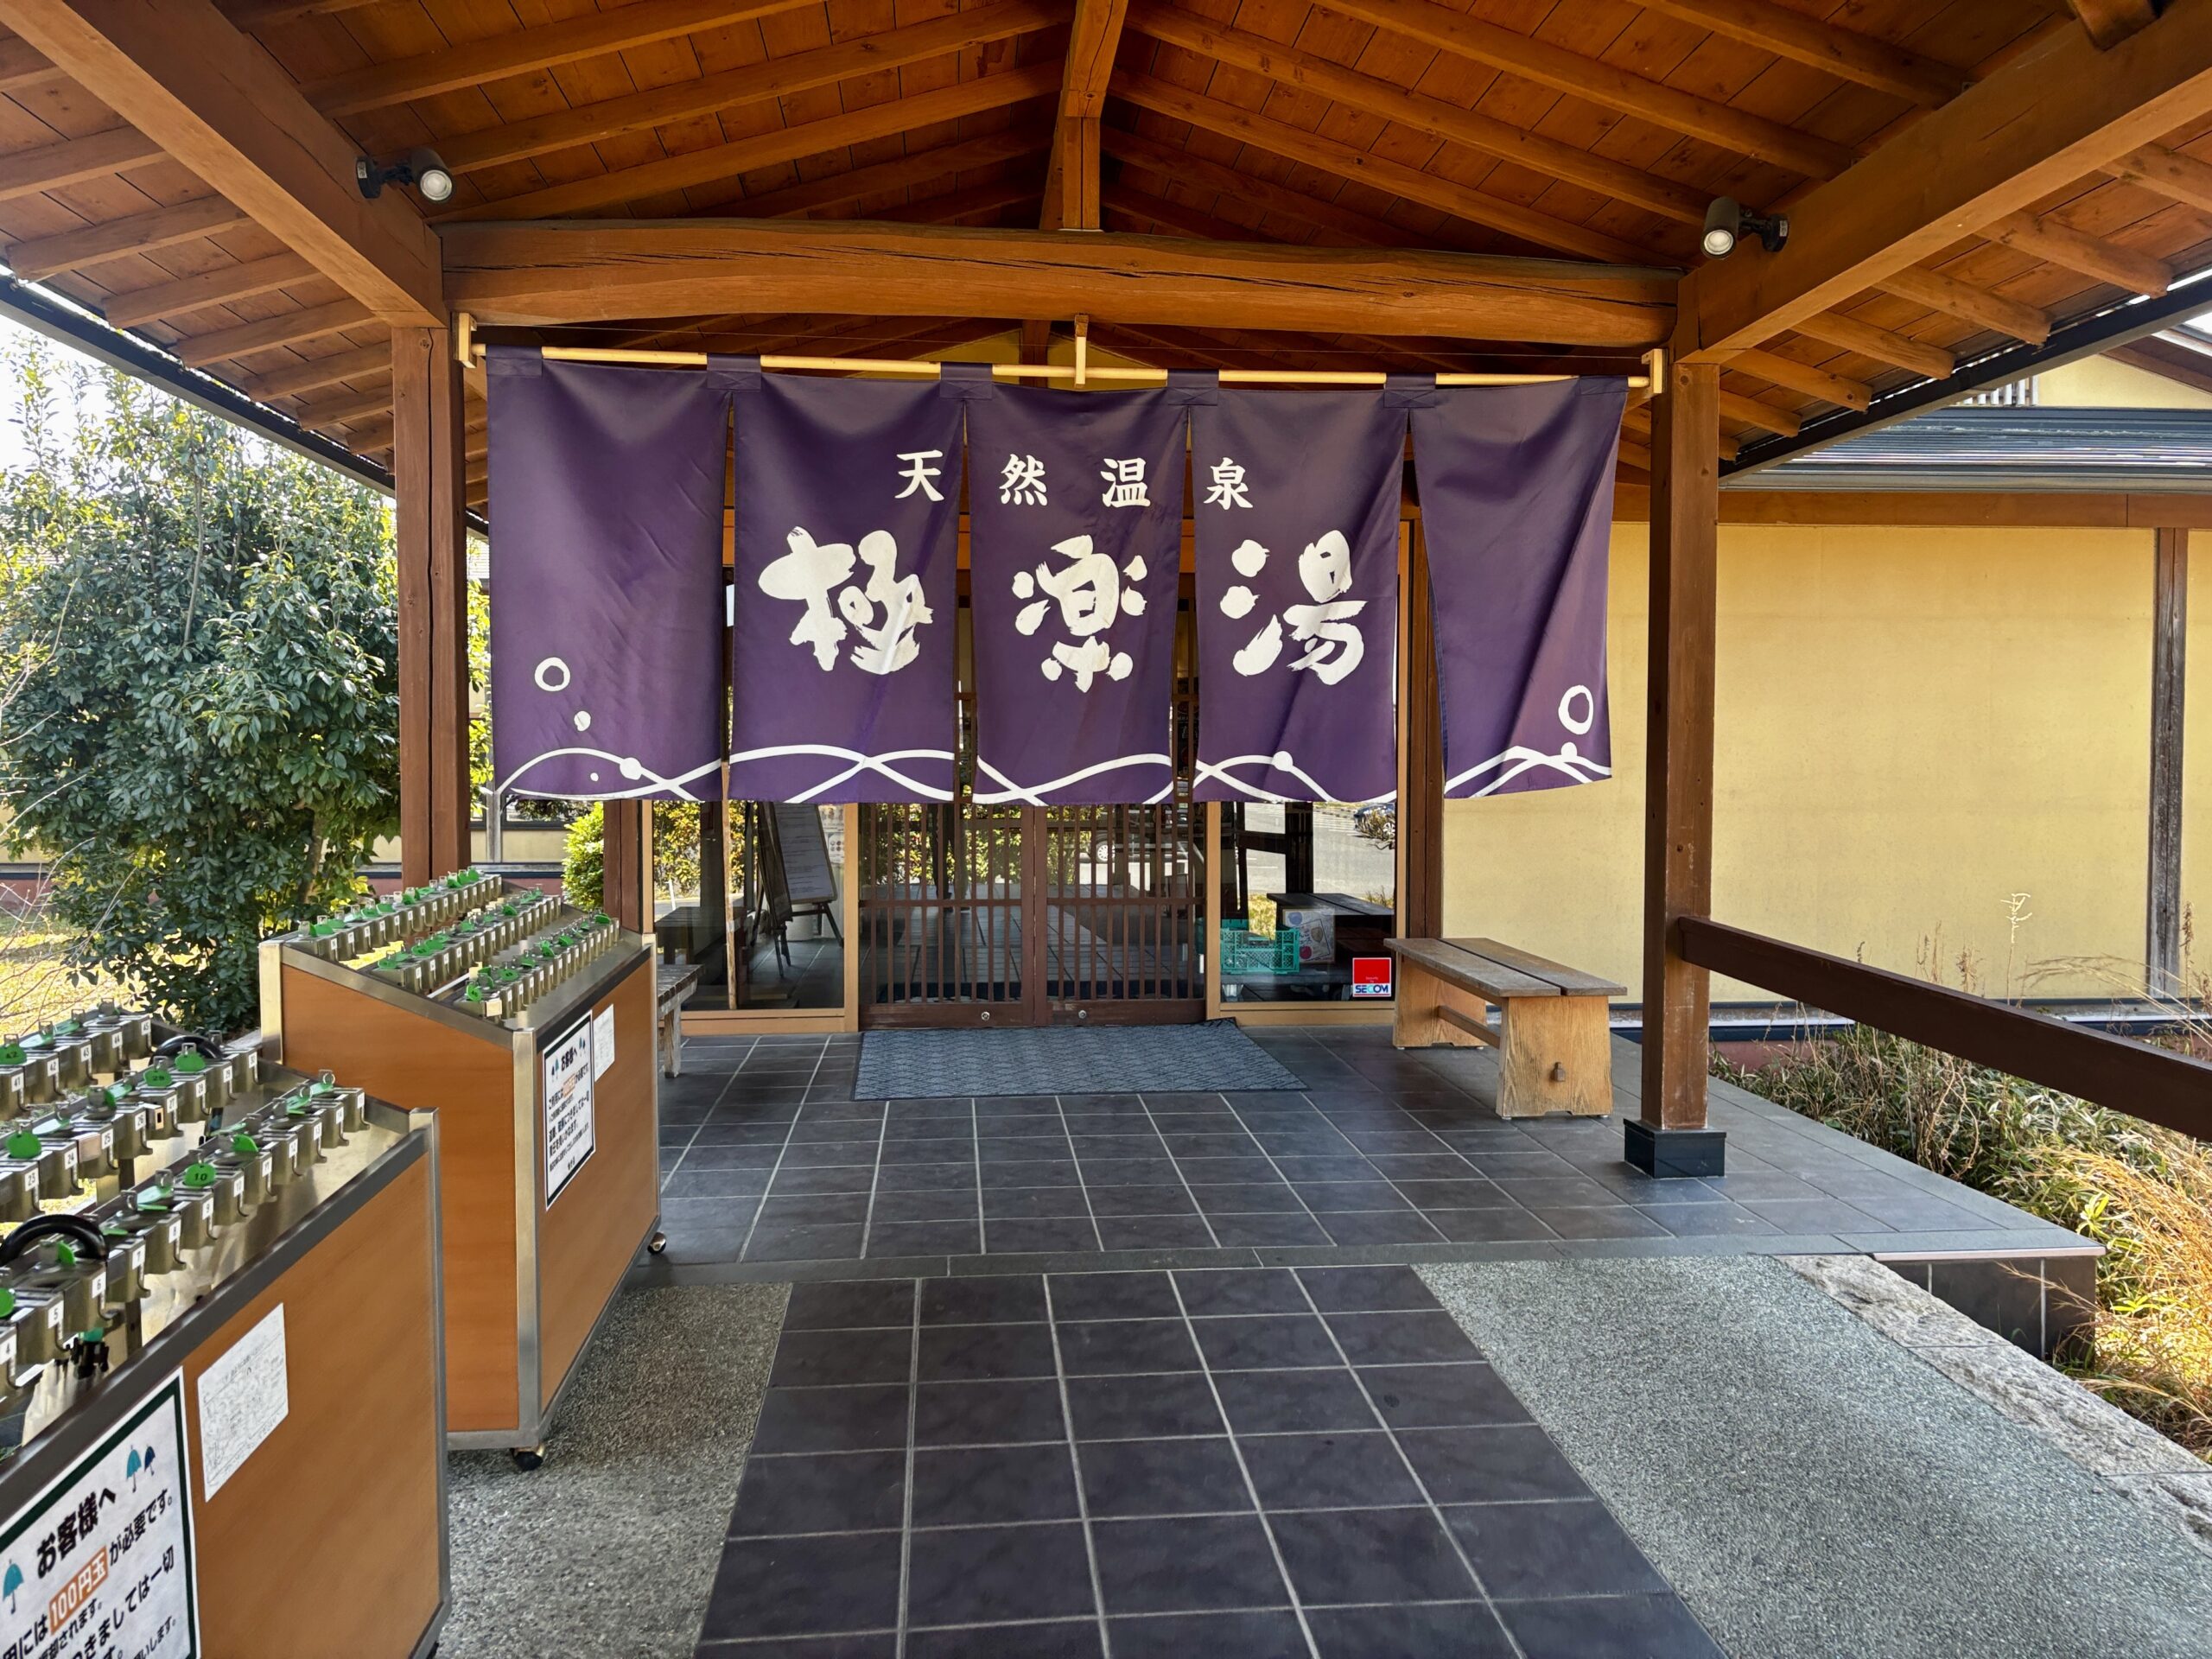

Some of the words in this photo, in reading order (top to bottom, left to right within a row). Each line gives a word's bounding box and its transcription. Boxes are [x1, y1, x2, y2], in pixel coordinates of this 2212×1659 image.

[895, 450, 1253, 510] 天然温泉
[758, 526, 1368, 693] 極楽湯
[1355, 984, 1389, 994] SECOM
[36, 1487, 117, 1580] お客様へ
